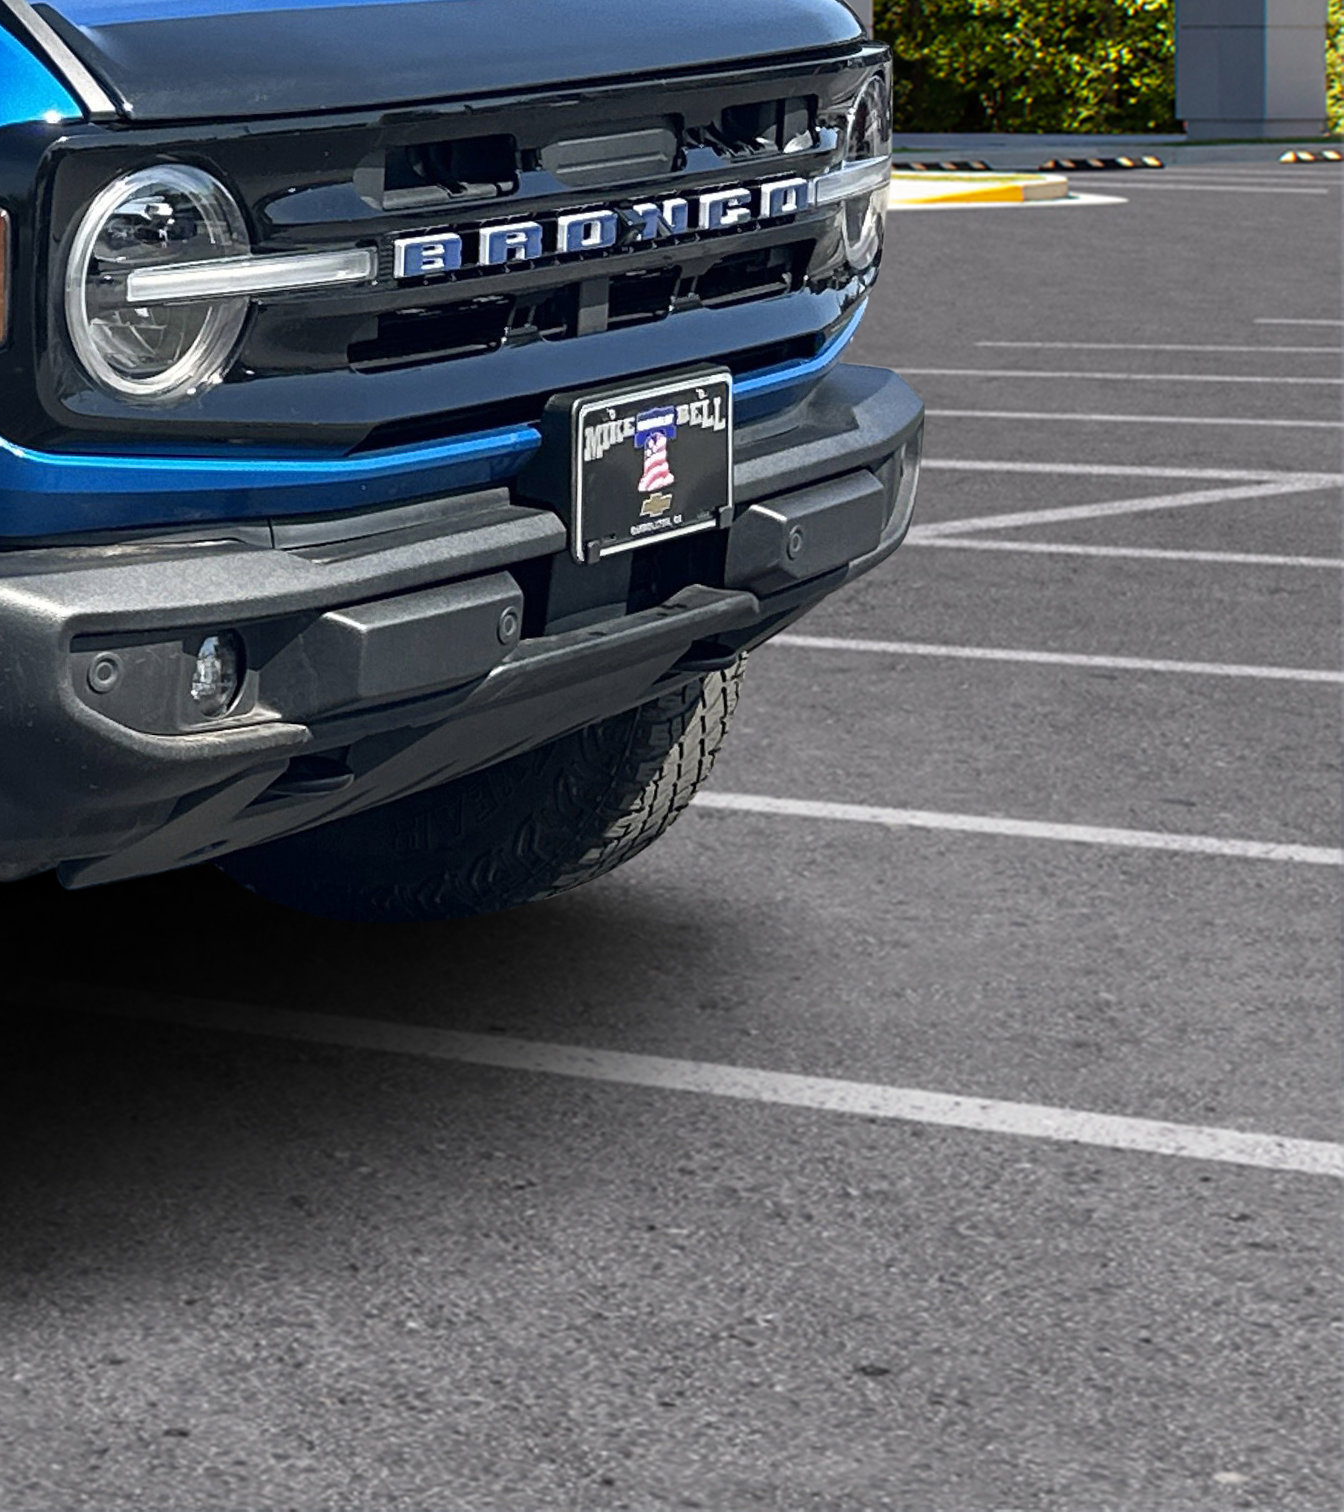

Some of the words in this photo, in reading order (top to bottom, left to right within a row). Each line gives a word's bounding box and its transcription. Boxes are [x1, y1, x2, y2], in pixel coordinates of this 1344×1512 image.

[393, 176, 809, 279] BRONCO
[583, 417, 636, 462] MIKE
[676, 396, 726, 432] BELL
